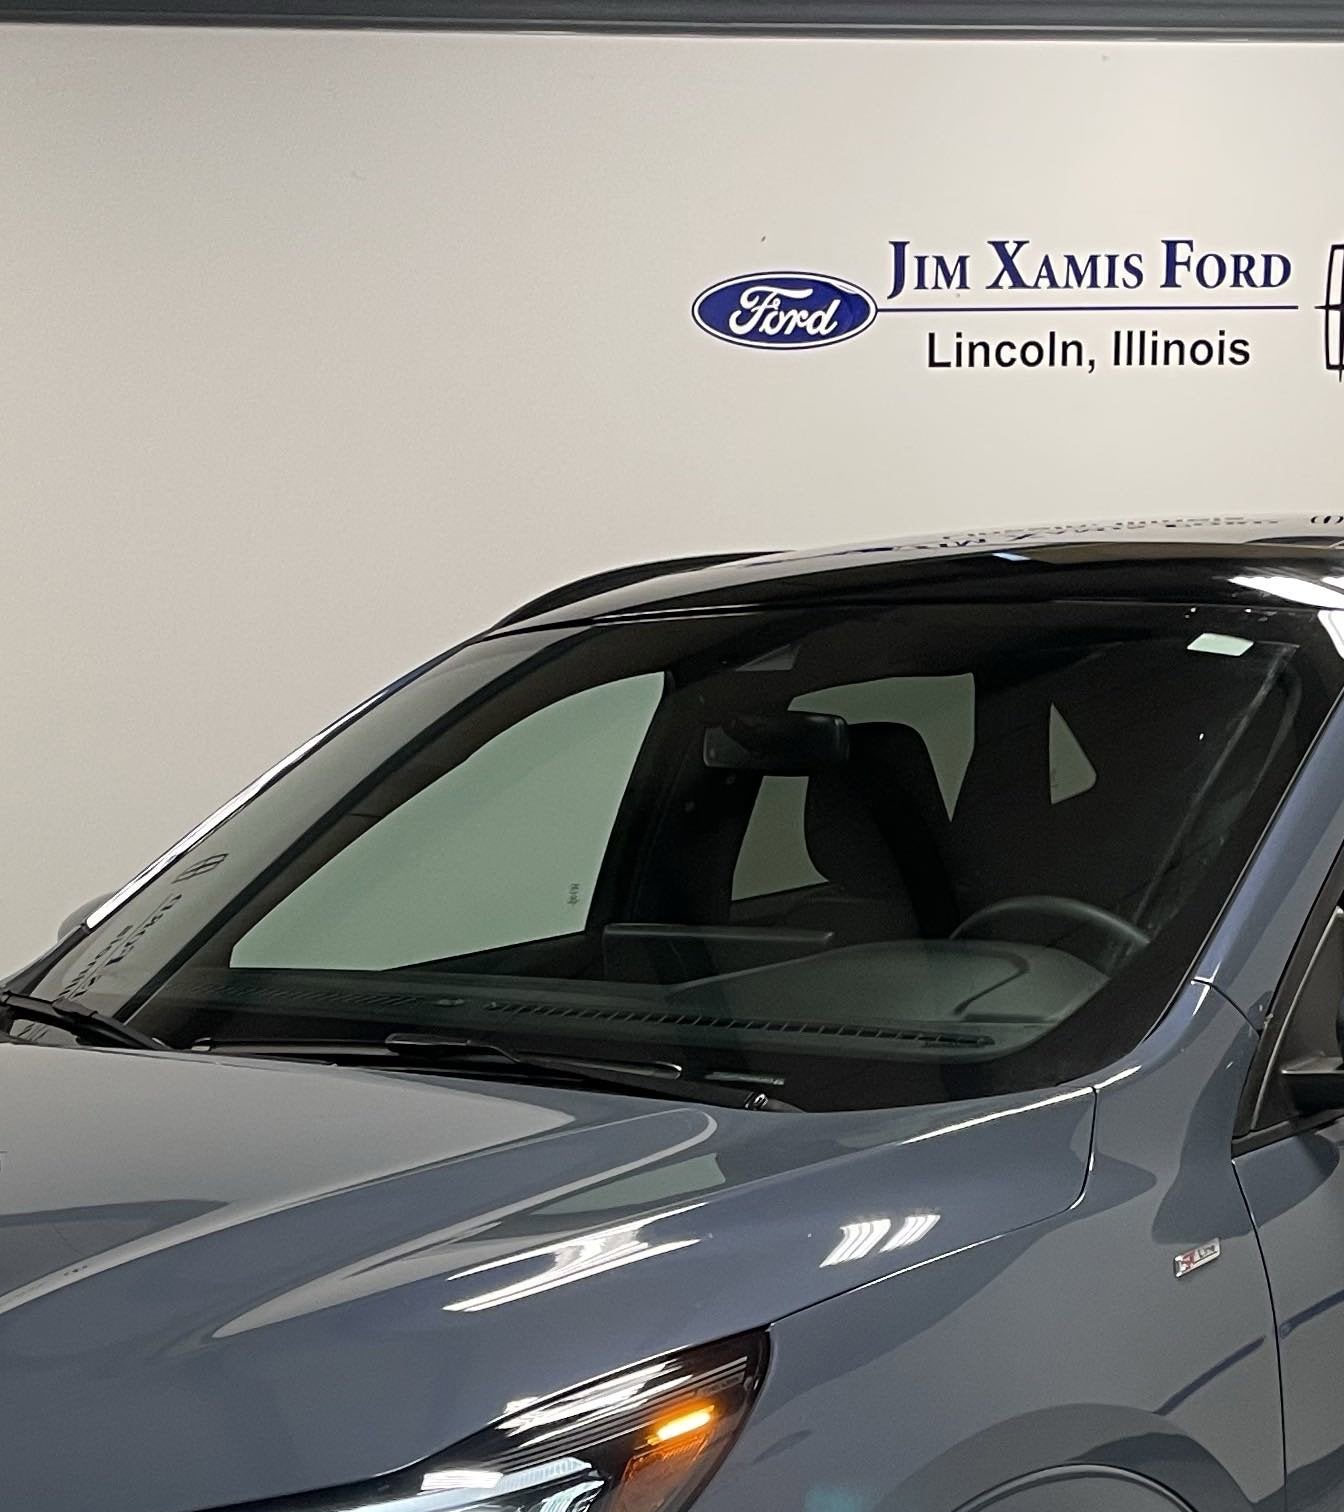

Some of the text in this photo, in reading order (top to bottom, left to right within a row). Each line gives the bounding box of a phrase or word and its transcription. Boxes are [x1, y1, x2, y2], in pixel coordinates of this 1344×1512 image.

[887, 239, 1292, 300] JIM XAMIS FORD
[729, 285, 839, 336] Ford
[927, 330, 1250, 373] Lincoln, Illinois
